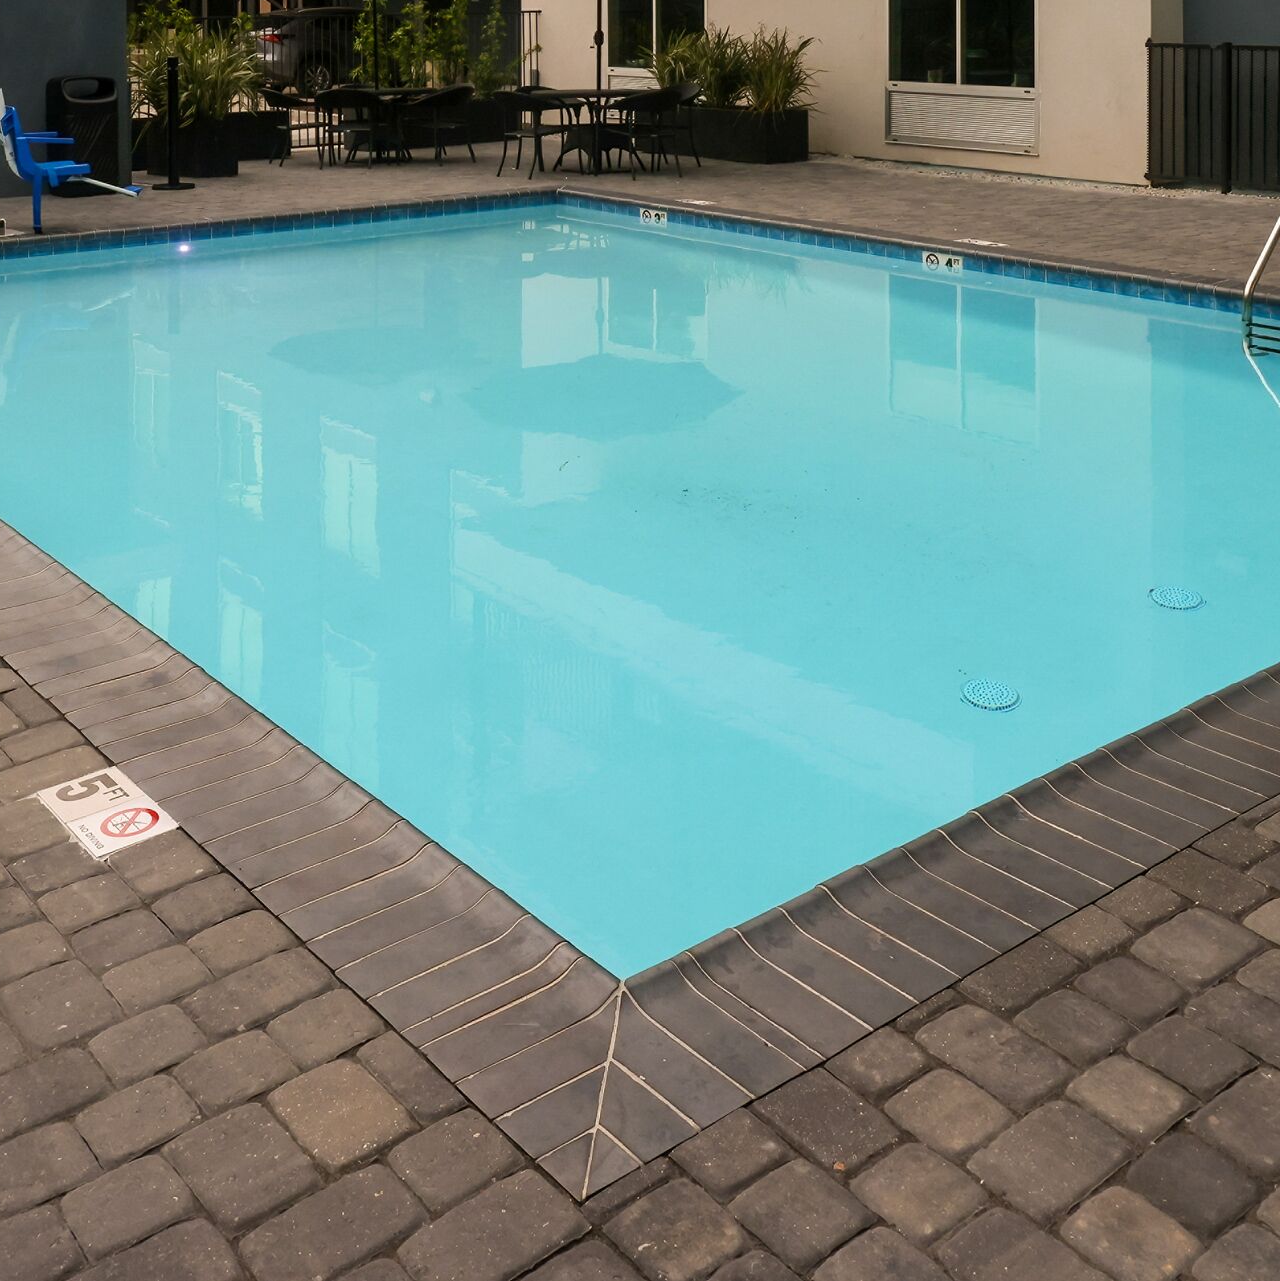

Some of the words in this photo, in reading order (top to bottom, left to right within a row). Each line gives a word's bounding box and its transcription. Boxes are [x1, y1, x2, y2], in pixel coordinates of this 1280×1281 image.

[55, 772, 119, 802] 5
[103, 786, 130, 802] FT
[78, 823, 89, 833] NO
[85, 832, 105, 850] DIVING
